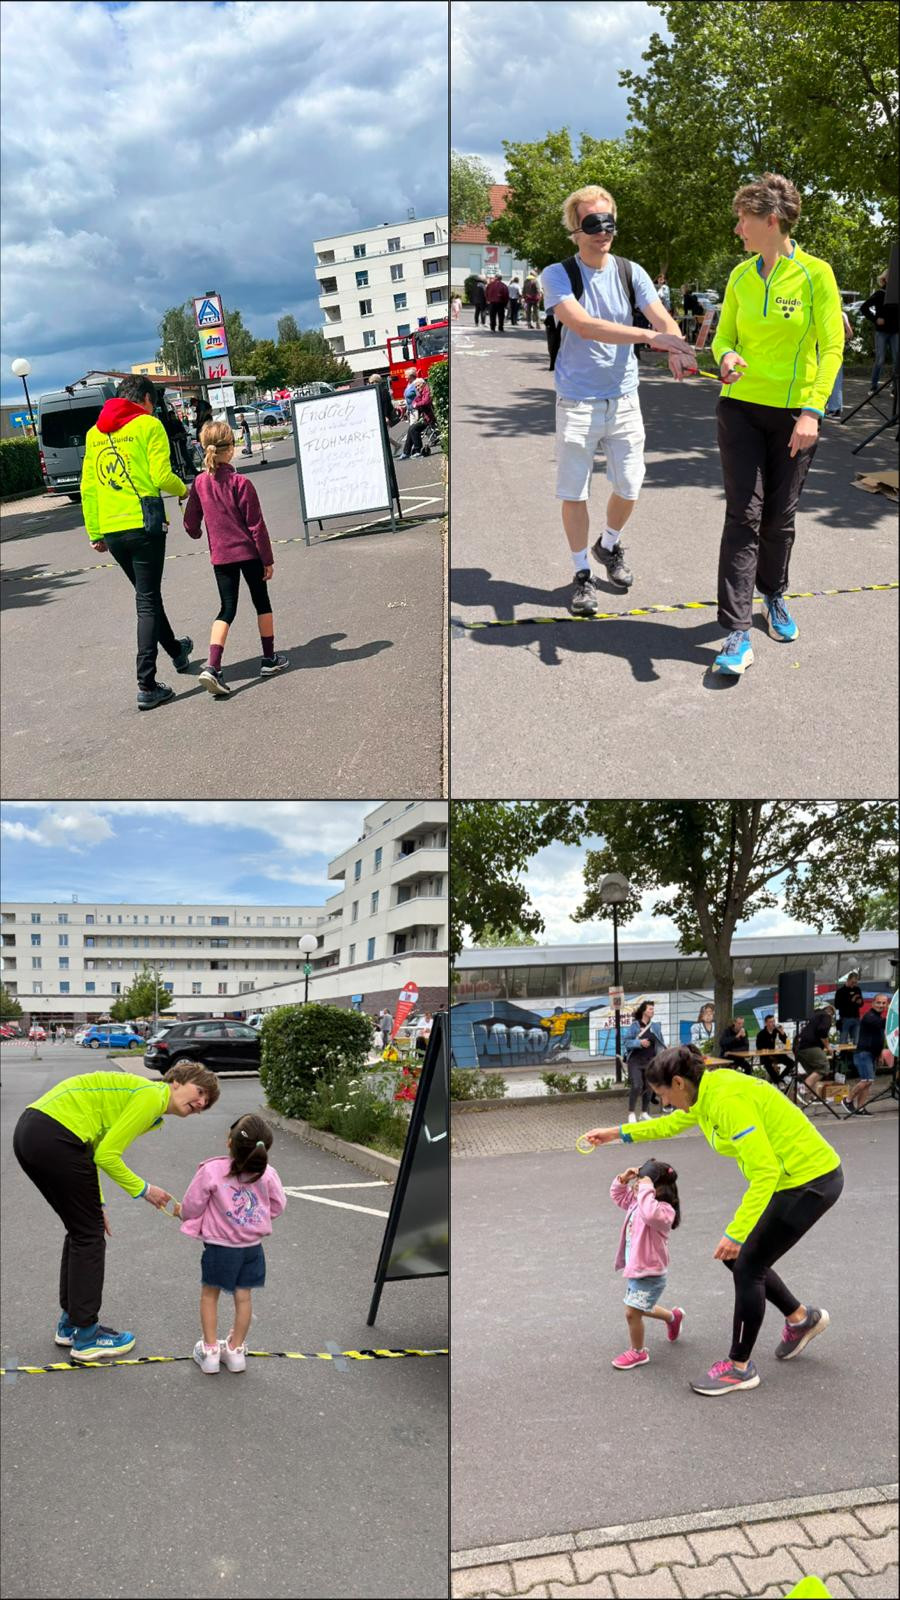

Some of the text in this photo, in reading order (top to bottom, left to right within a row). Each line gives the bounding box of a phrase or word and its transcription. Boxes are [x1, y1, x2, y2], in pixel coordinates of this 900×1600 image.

[775, 296, 802, 306] Guide
[201, 316, 219, 326] ALDI
[207, 335, 221, 345] dm
[303, 429, 378, 451] FLOHMARKT
